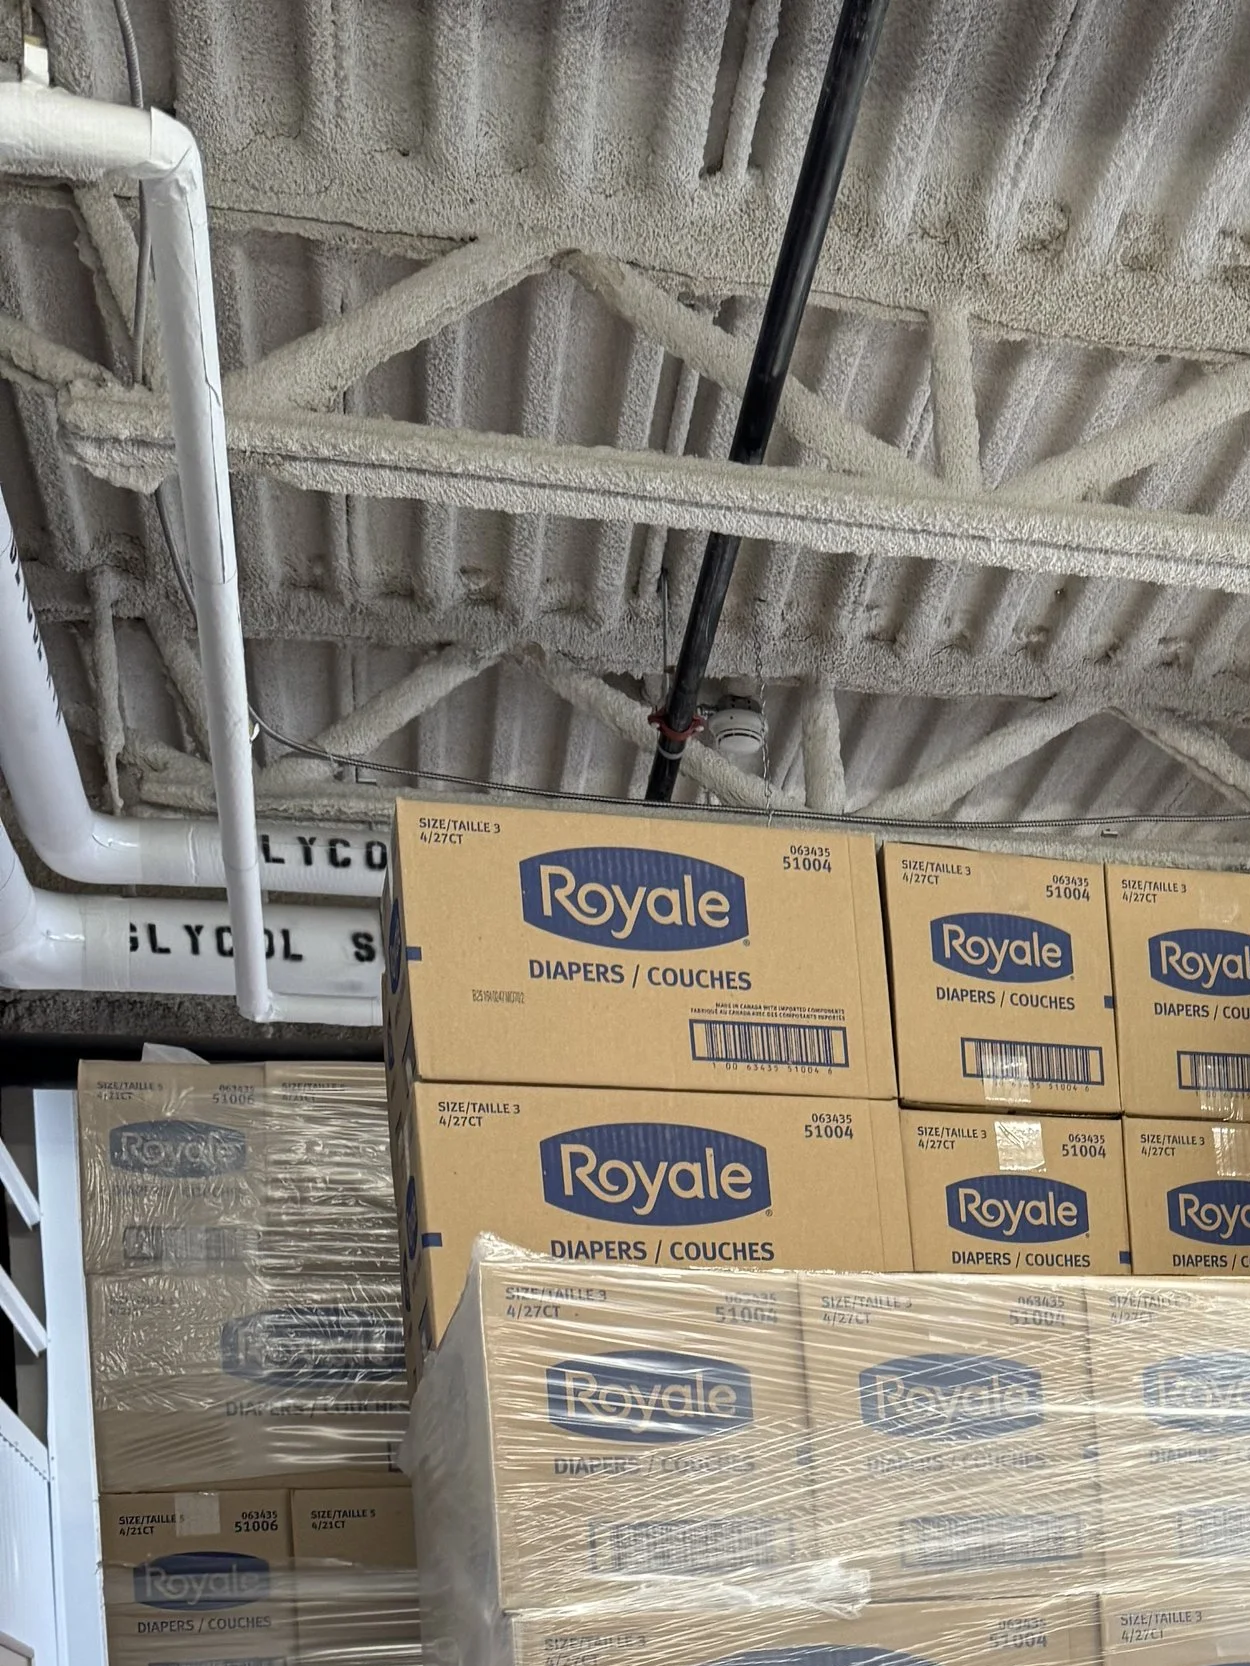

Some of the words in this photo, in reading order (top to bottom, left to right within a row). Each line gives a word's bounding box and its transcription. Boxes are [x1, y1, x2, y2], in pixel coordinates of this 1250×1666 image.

[419, 817, 490, 833] SIZE/TAILLE
[420, 831, 463, 845] 4/27CT
[790, 844, 831, 858] 063435
[782, 856, 832, 873] 51004
[902, 859, 962, 876] SIZE/TAILLE
[902, 873, 940, 885] 4/27CT
[1052, 874, 1089, 887] 063435
[1121, 879, 1179, 894] SIZE/TAILLE
[1045, 884, 1090, 902] 51004
[1122, 891, 1157, 903] 4/27CT
[539, 864, 731, 939] Royale
[943, 923, 1062, 973] Royale
[529, 959, 625, 985] DIAPERS
[647, 966, 752, 991] COUCHES
[936, 986, 996, 1005] DIAPERS
[1010, 991, 1075, 1010] COUCHES
[1154, 1002, 1209, 1019] DIAPERS
[438, 1102, 510, 1115] SIZE/TAILLE
[439, 1115, 483, 1128] 4/27CT
[811, 1112, 853, 1125] 063435
[804, 1124, 853, 1140] 51004
[1061, 1143, 1106, 1159] 51004
[560, 1143, 753, 1215] Royale
[958, 1185, 1078, 1235] Royale
[550, 1240, 647, 1264] DIAPERS
[669, 1241, 774, 1261] COUCHES
[951, 1250, 1012, 1266] DIAPERS
[1025, 1253, 1090, 1269] COUCHES
[1172, 1253, 1228, 1269] DIAPERS
[563, 1370, 738, 1435] Royale
[311, 1509, 368, 1520] SIZE/TAILLE
[234, 1519, 278, 1533] 51006
[137, 1619, 194, 1634] DIAPERS
[207, 1616, 272, 1631] COUCHES
